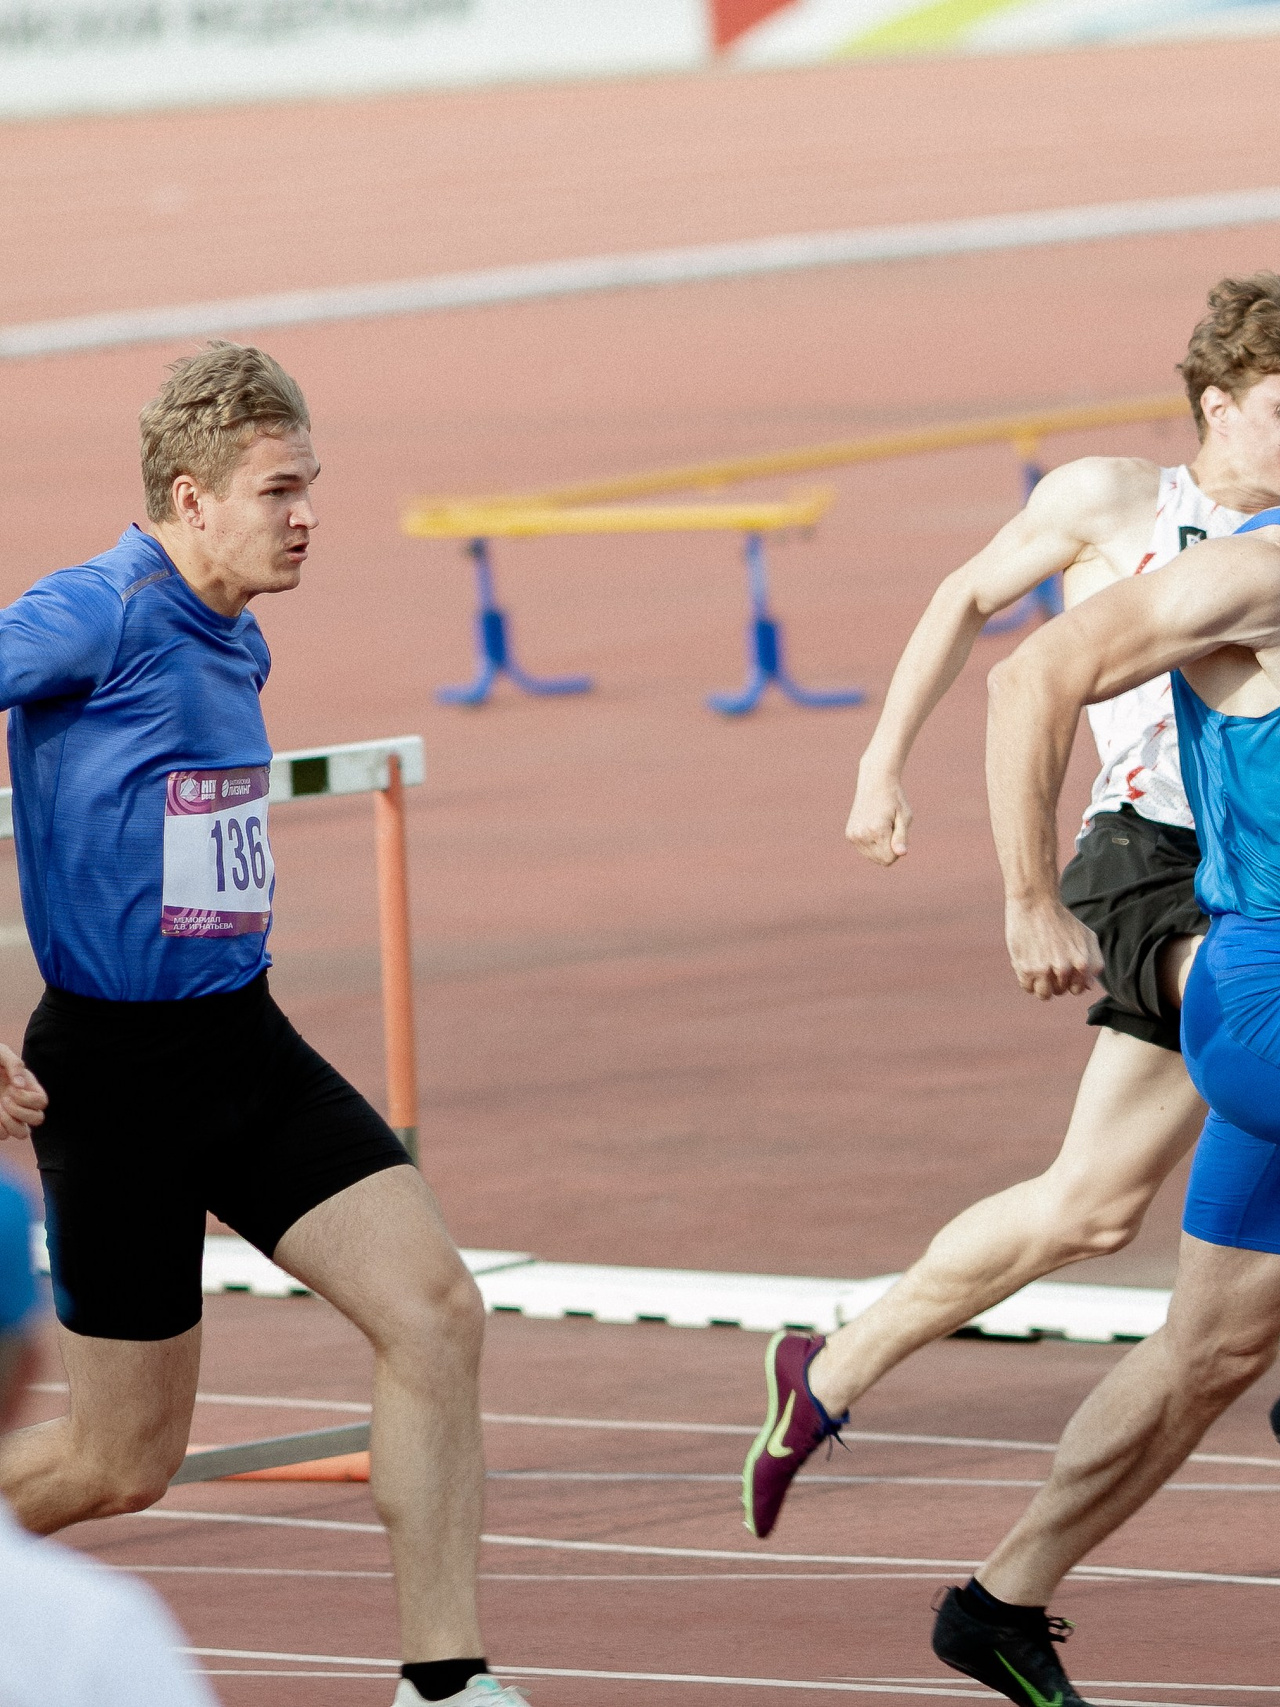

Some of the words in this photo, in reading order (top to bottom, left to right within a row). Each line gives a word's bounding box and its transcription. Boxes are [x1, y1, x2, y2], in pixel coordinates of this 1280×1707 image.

[228, 785, 251, 796] ЛИЗИНГ
[211, 816, 266, 893] 136
[174, 916, 221, 924] МЕМОРИАЛ
[189, 922, 234, 930] ИГНАТЬЕВА
